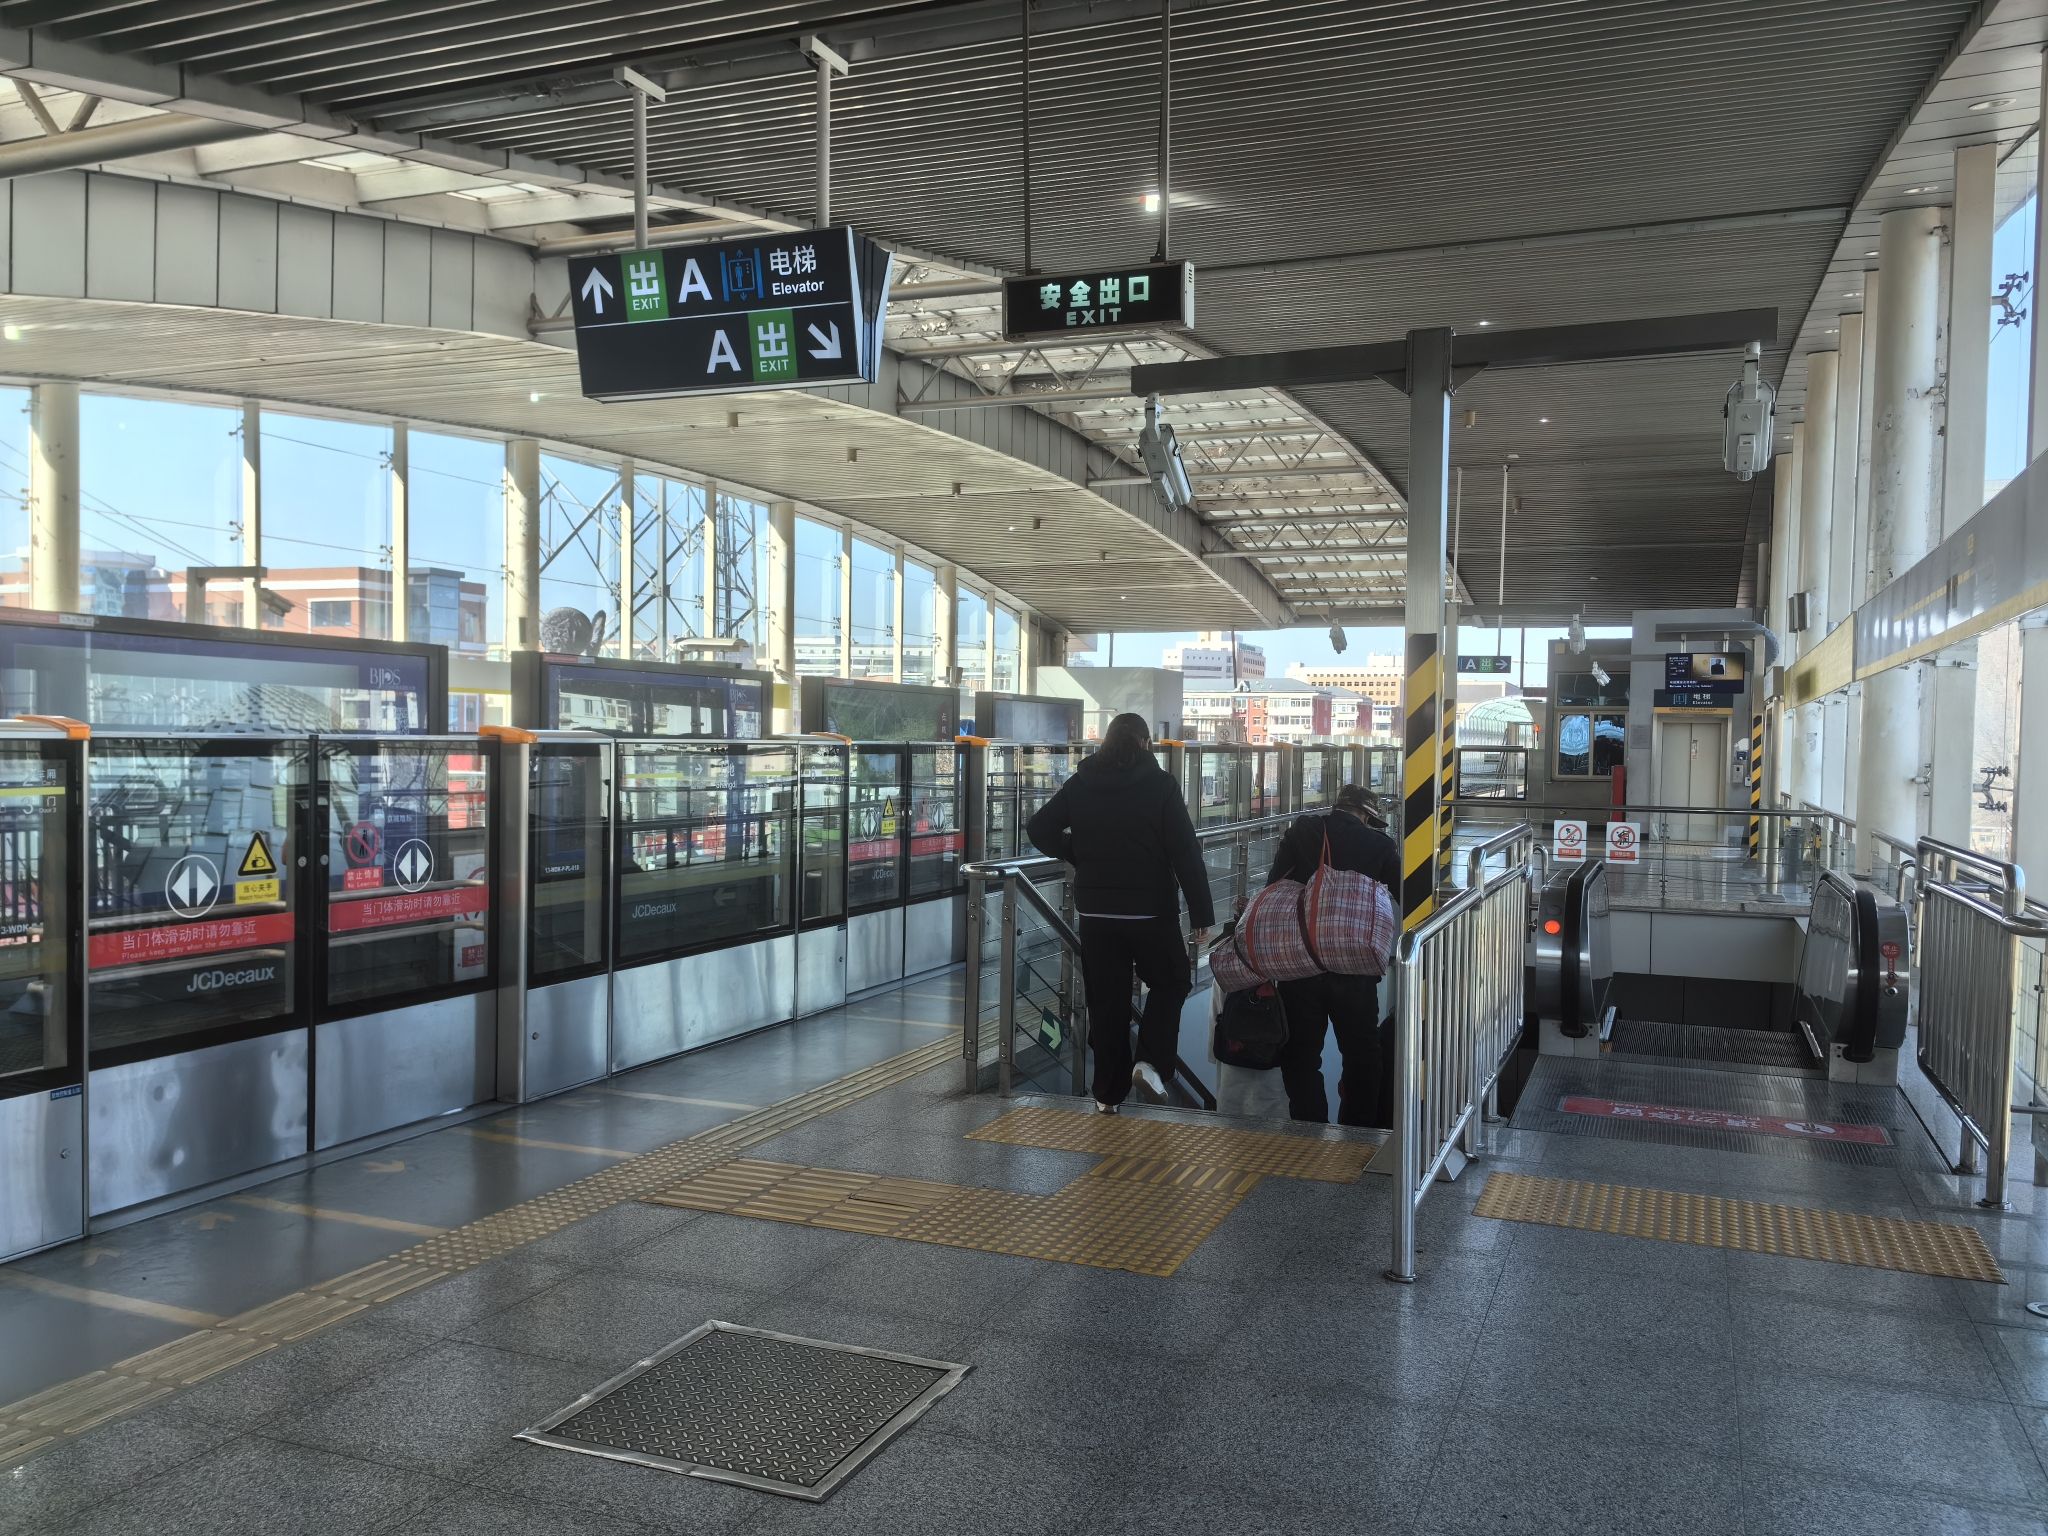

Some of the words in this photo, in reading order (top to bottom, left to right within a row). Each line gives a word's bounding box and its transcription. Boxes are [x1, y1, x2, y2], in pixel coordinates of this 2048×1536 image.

[769, 244, 818, 277] 电梯
[629, 260, 660, 297] 出
[678, 258, 713, 304] A
[772, 279, 825, 296] Elevator
[632, 297, 661, 312] EXIT
[1040, 275, 1150, 310] 安全出口
[1066, 307, 1122, 326] EXIT
[706, 329, 742, 374] A
[757, 321, 789, 358] 出
[759, 359, 790, 374] EXIT
[1465, 658, 1477, 670] A
[363, 892, 461, 917] 当门体滑动时请勿靠近
[632, 902, 677, 919] JCDecaux
[122, 920, 257, 950] 当门体滑动时请勿靠近
[186, 966, 276, 993] JCDecaux
